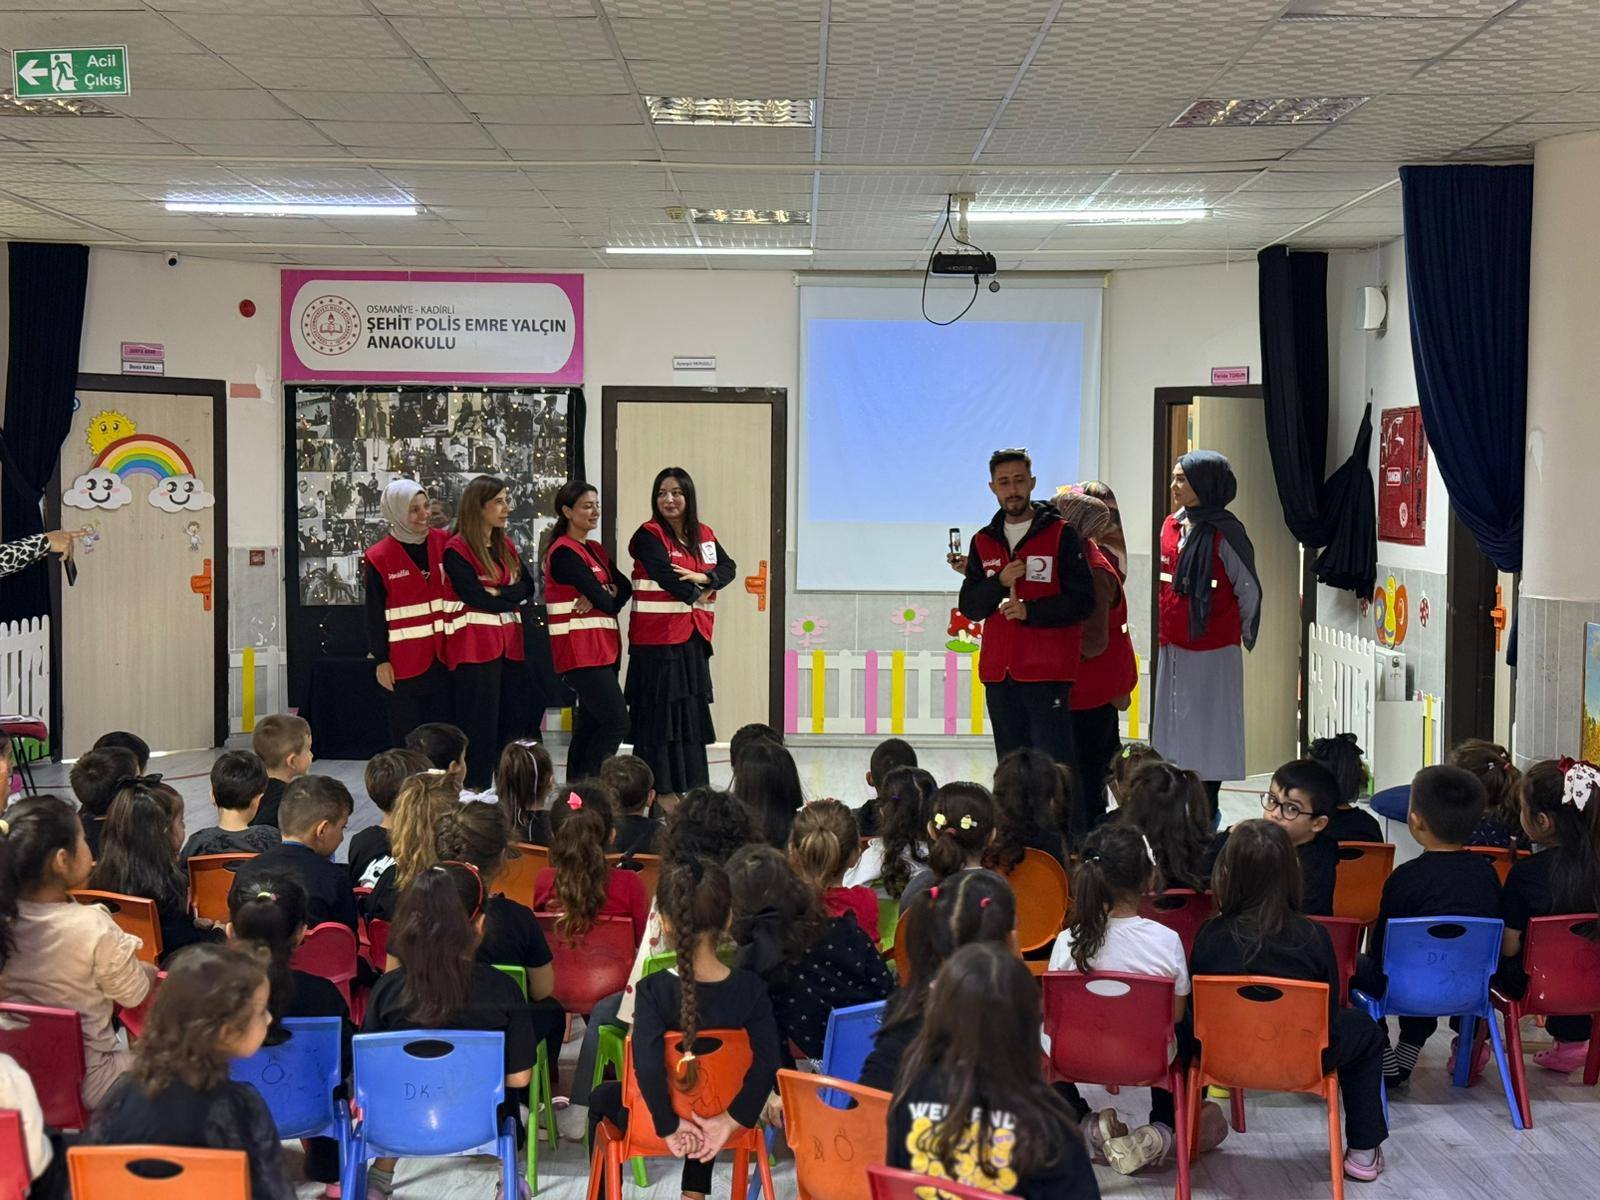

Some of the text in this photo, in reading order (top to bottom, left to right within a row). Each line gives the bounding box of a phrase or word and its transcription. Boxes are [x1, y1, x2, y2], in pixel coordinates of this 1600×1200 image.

[86, 54, 116, 68] Acil
[84, 73, 122, 89] Çıkış
[366, 304, 414, 314] OSMANİYE
[420, 304, 455, 315] KADİRLİ
[367, 315, 412, 333] ŞEHİT
[416, 315, 461, 332] POLİS
[465, 318, 508, 332] EMRE
[511, 318, 566, 336] YALÇIN
[366, 336, 456, 350] ANAOKULU
